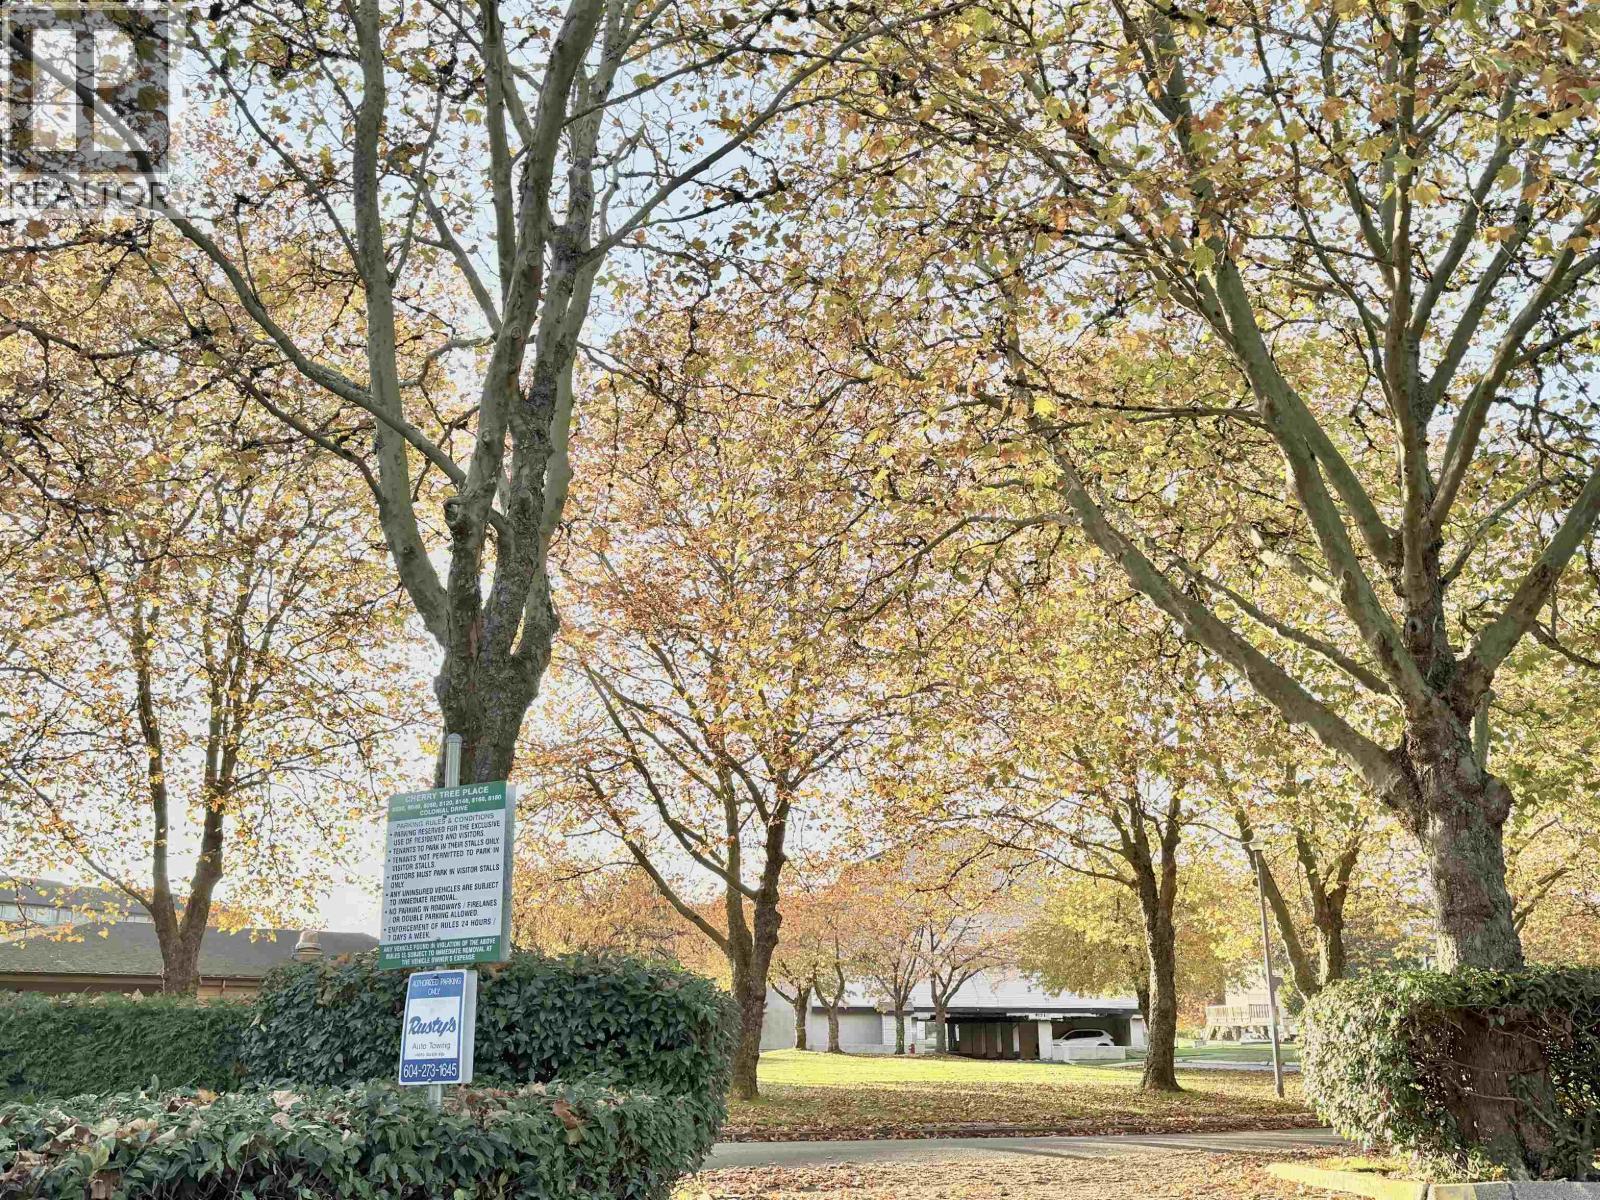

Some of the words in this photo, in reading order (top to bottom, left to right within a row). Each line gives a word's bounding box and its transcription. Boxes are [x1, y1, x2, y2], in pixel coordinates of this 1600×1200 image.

[405, 792, 437, 803] CHERRY
[440, 789, 460, 799] TREE
[462, 786, 489, 796] PLACE
[420, 808, 449, 816] COLONIAL
[450, 805, 468, 813] DRIVE
[396, 821, 424, 829] PARKING
[425, 818, 446, 826] RULES
[454, 812, 495, 823] CONDITIONS
[394, 829, 416, 838] PARKING
[417, 826, 445, 836] RESERVED
[472, 821, 500, 829] EXCLUSIVE
[414, 834, 444, 843] RESIDENTS
[459, 830, 485, 839] VISITORS.
[393, 847, 416, 855] TENANTS
[448, 841, 463, 849] THEIR
[465, 839, 484, 847] STALLS
[393, 855, 416, 863] TENANTS
[432, 851, 464, 860] PERMITTED
[392, 864, 413, 872] VISITOR
[415, 861, 436, 869] STALLS.
[392, 872, 415, 881] VISITORS
[417, 870, 432, 878] MUST
[457, 866, 478, 874] VISITOR
[480, 864, 499, 872] STALLS
[402, 888, 433, 897] UNINSURED
[435, 885, 460, 894] VEHICLES
[474, 881, 499, 890] SUBJECT
[399, 896, 428, 905] IMMEDIATE
[430, 894, 457, 902] REMOVAL.
[398, 906, 421, 914] PARKING
[431, 903, 461, 911] ROADWAYS
[467, 899, 498, 908] FIRELANES
[401, 914, 423, 923] DOUBLE
[425, 912, 449, 920] PARKING
[388, 924, 429, 933] ENFORCEMENT
[441, 920, 459, 929] RULES
[470, 918, 491, 926] HOURS
[394, 944, 413, 952] VEHICLE
[462, 946, 485, 954] REMOVAL
[413, 979, 439, 987] AUTHORIZED
[440, 977, 462, 986] PARKING
[428, 987, 441, 995] ONLY
[408, 1016, 456, 1037] Rusty's
[412, 1042, 427, 1050] Auto
[429, 1041, 451, 1050] Towing
[403, 1063, 457, 1078] 604-273-1645
